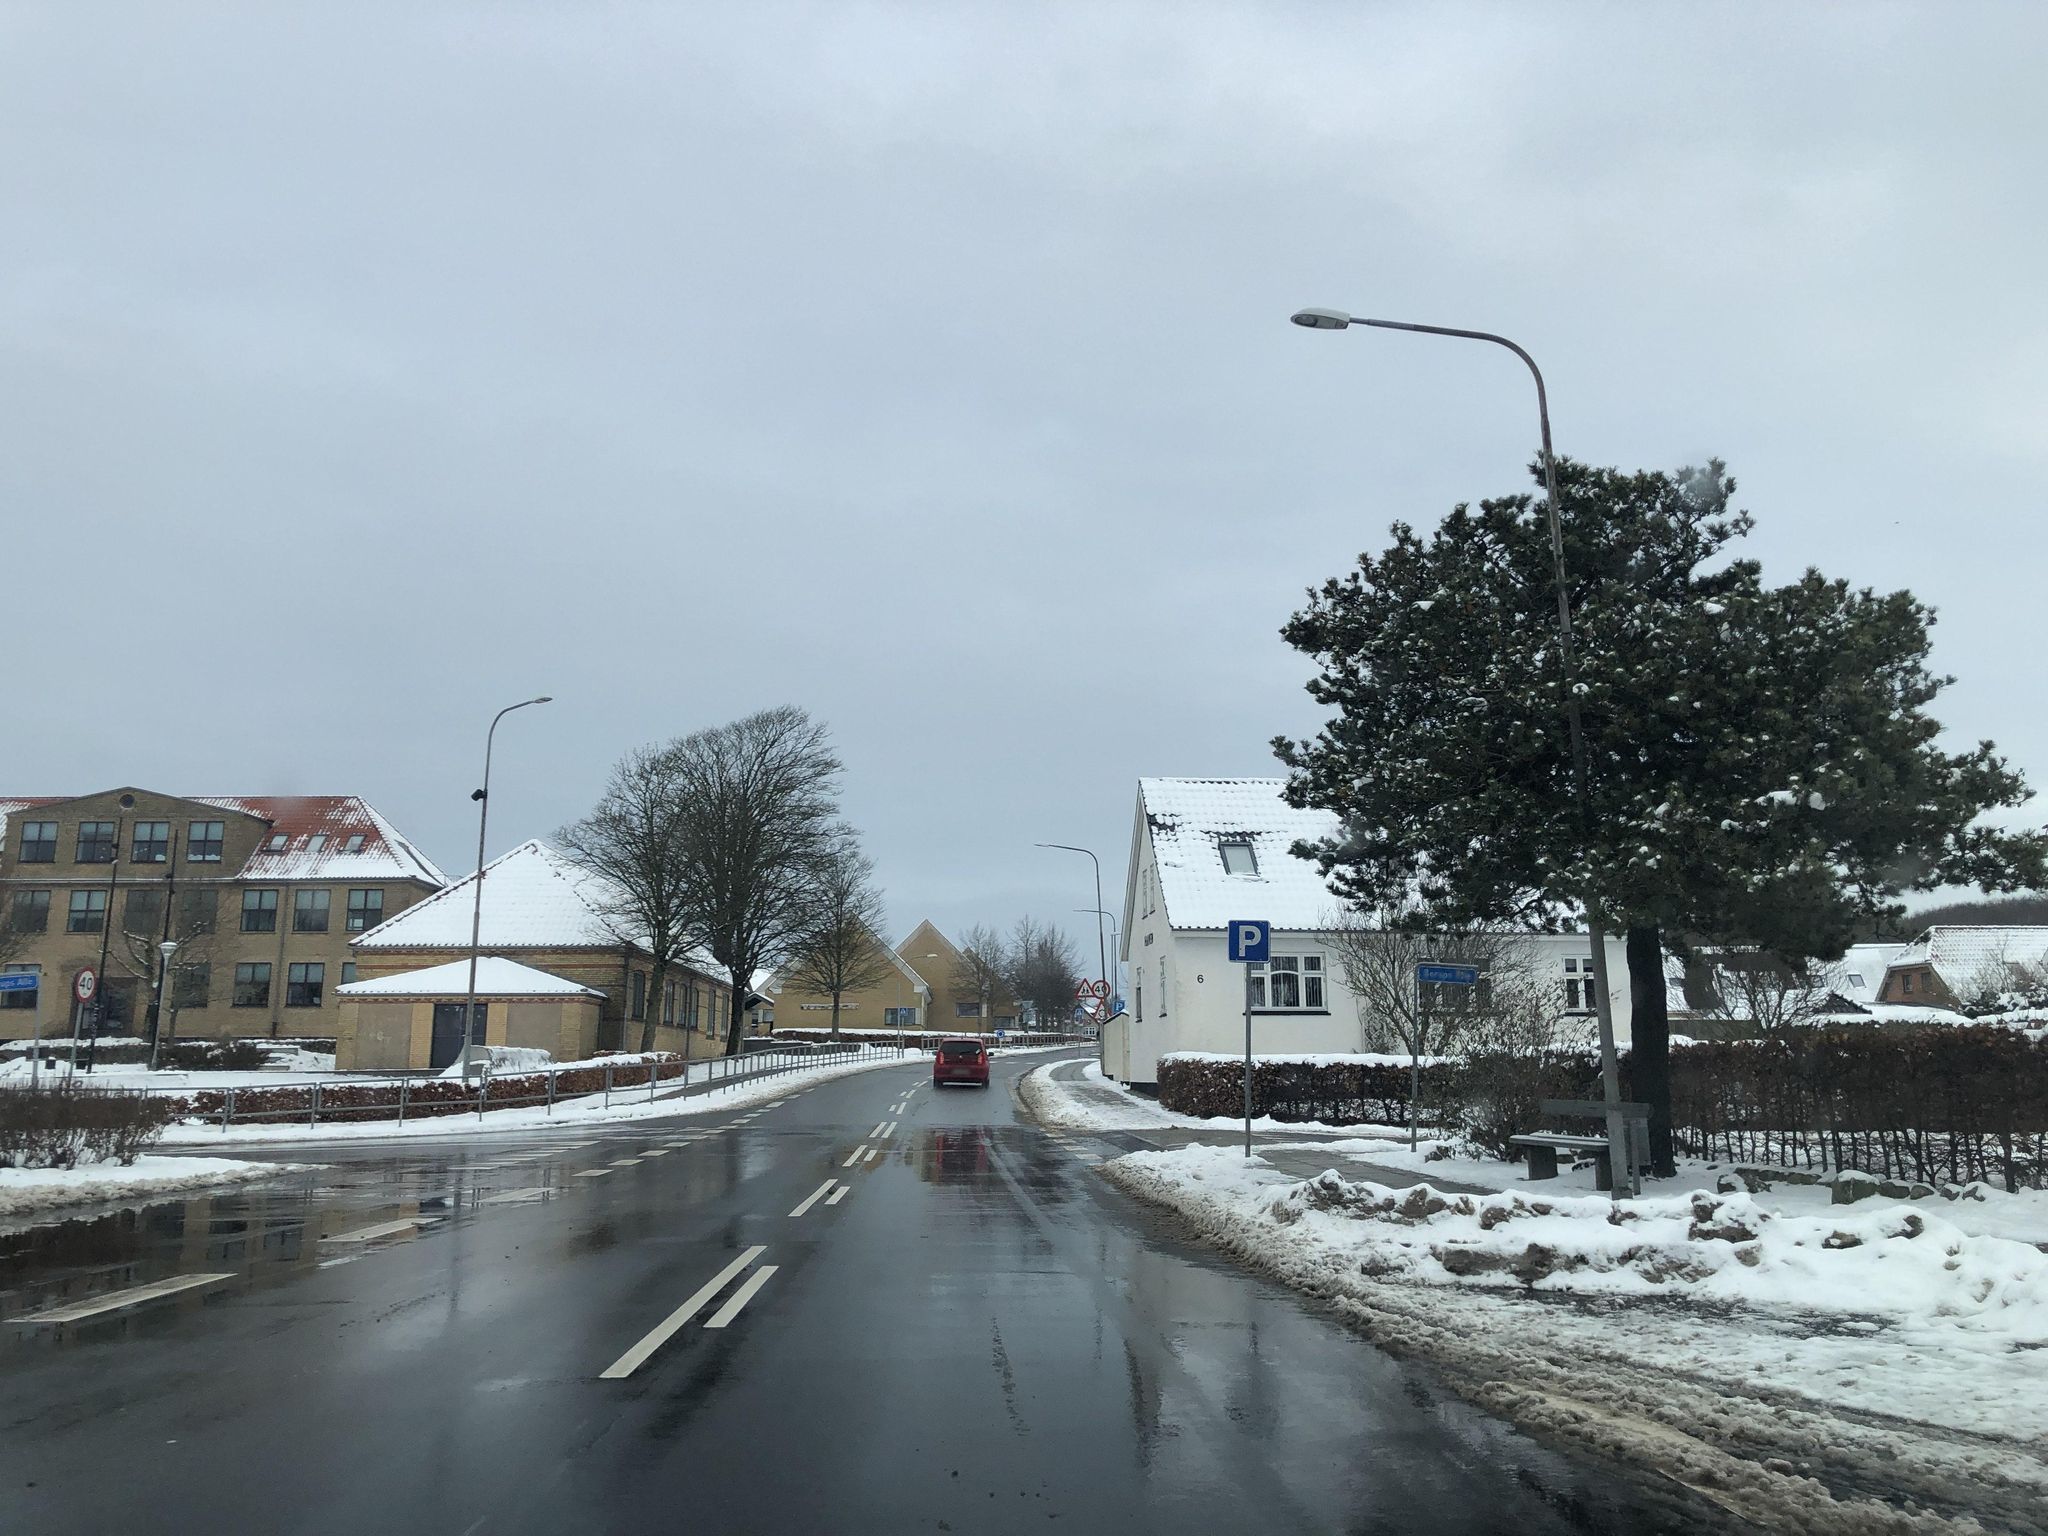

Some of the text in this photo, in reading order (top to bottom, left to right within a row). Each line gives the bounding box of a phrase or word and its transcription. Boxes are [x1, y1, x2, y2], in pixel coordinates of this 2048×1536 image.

[1239, 925, 1261, 956] P
[79, 977, 93, 990] 40
[1197, 975, 1204, 983] 6
